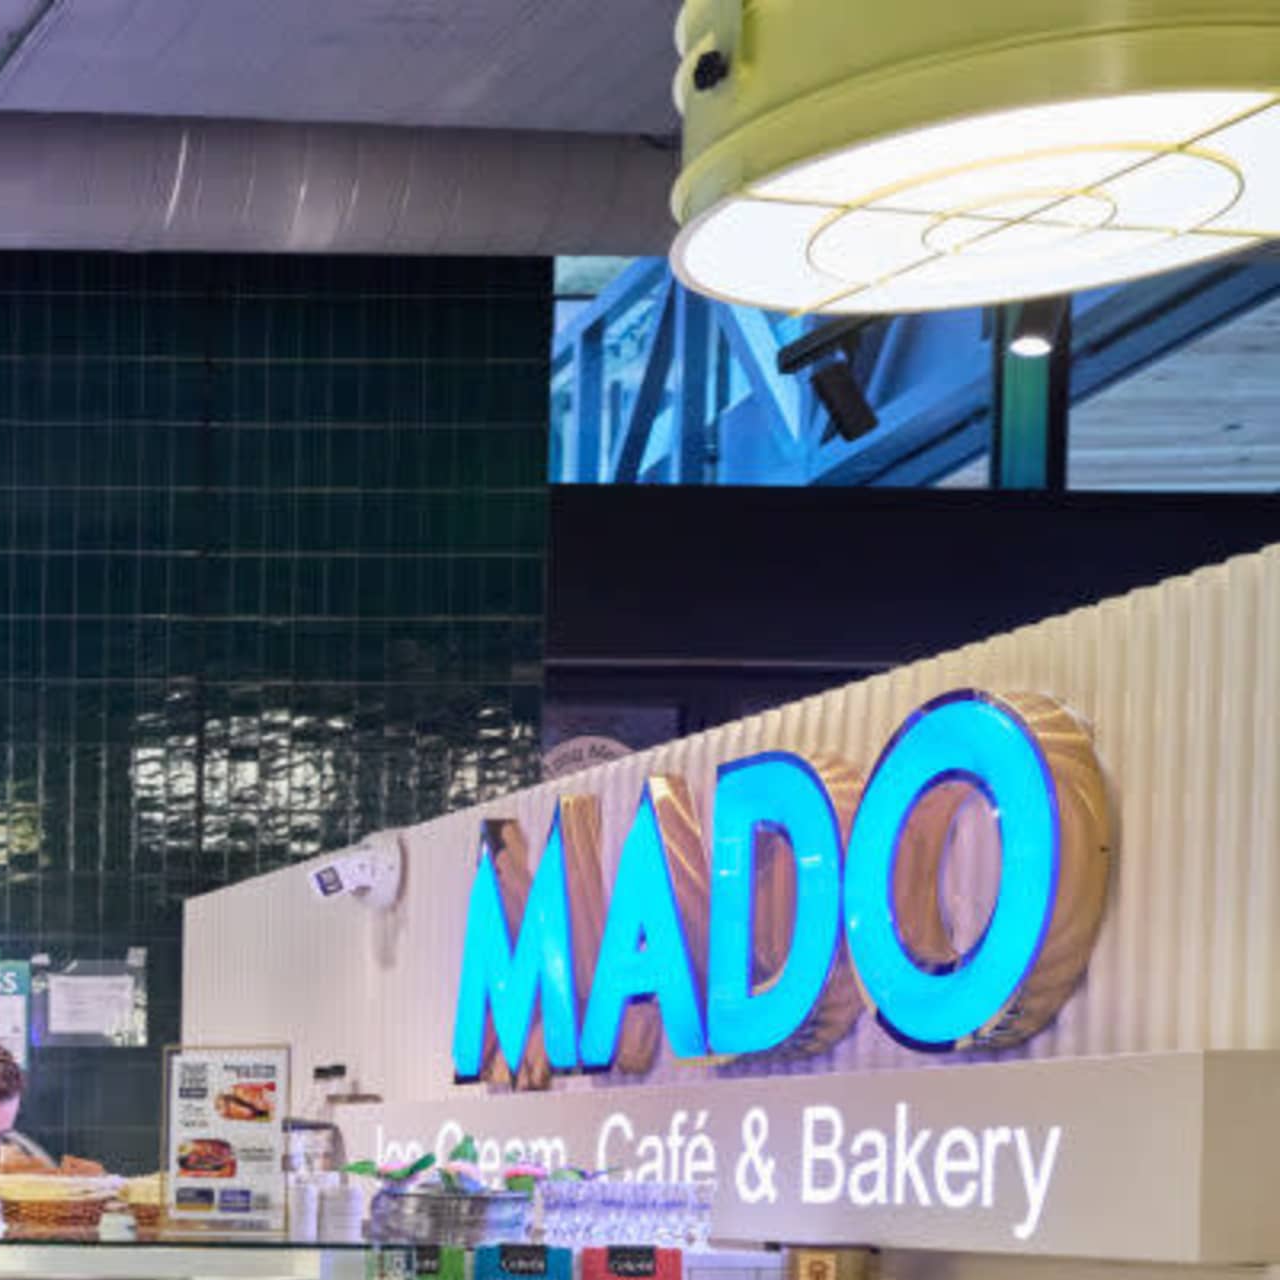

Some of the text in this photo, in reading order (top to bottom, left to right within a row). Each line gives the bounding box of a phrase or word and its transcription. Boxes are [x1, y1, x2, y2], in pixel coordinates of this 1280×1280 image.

[452, 687, 1062, 1086] MADO
[436, 1119, 567, 1177] Ceam
[597, 1109, 716, 1184] Café
[735, 1106, 777, 1204] &
[801, 1101, 1062, 1241] Bakery
